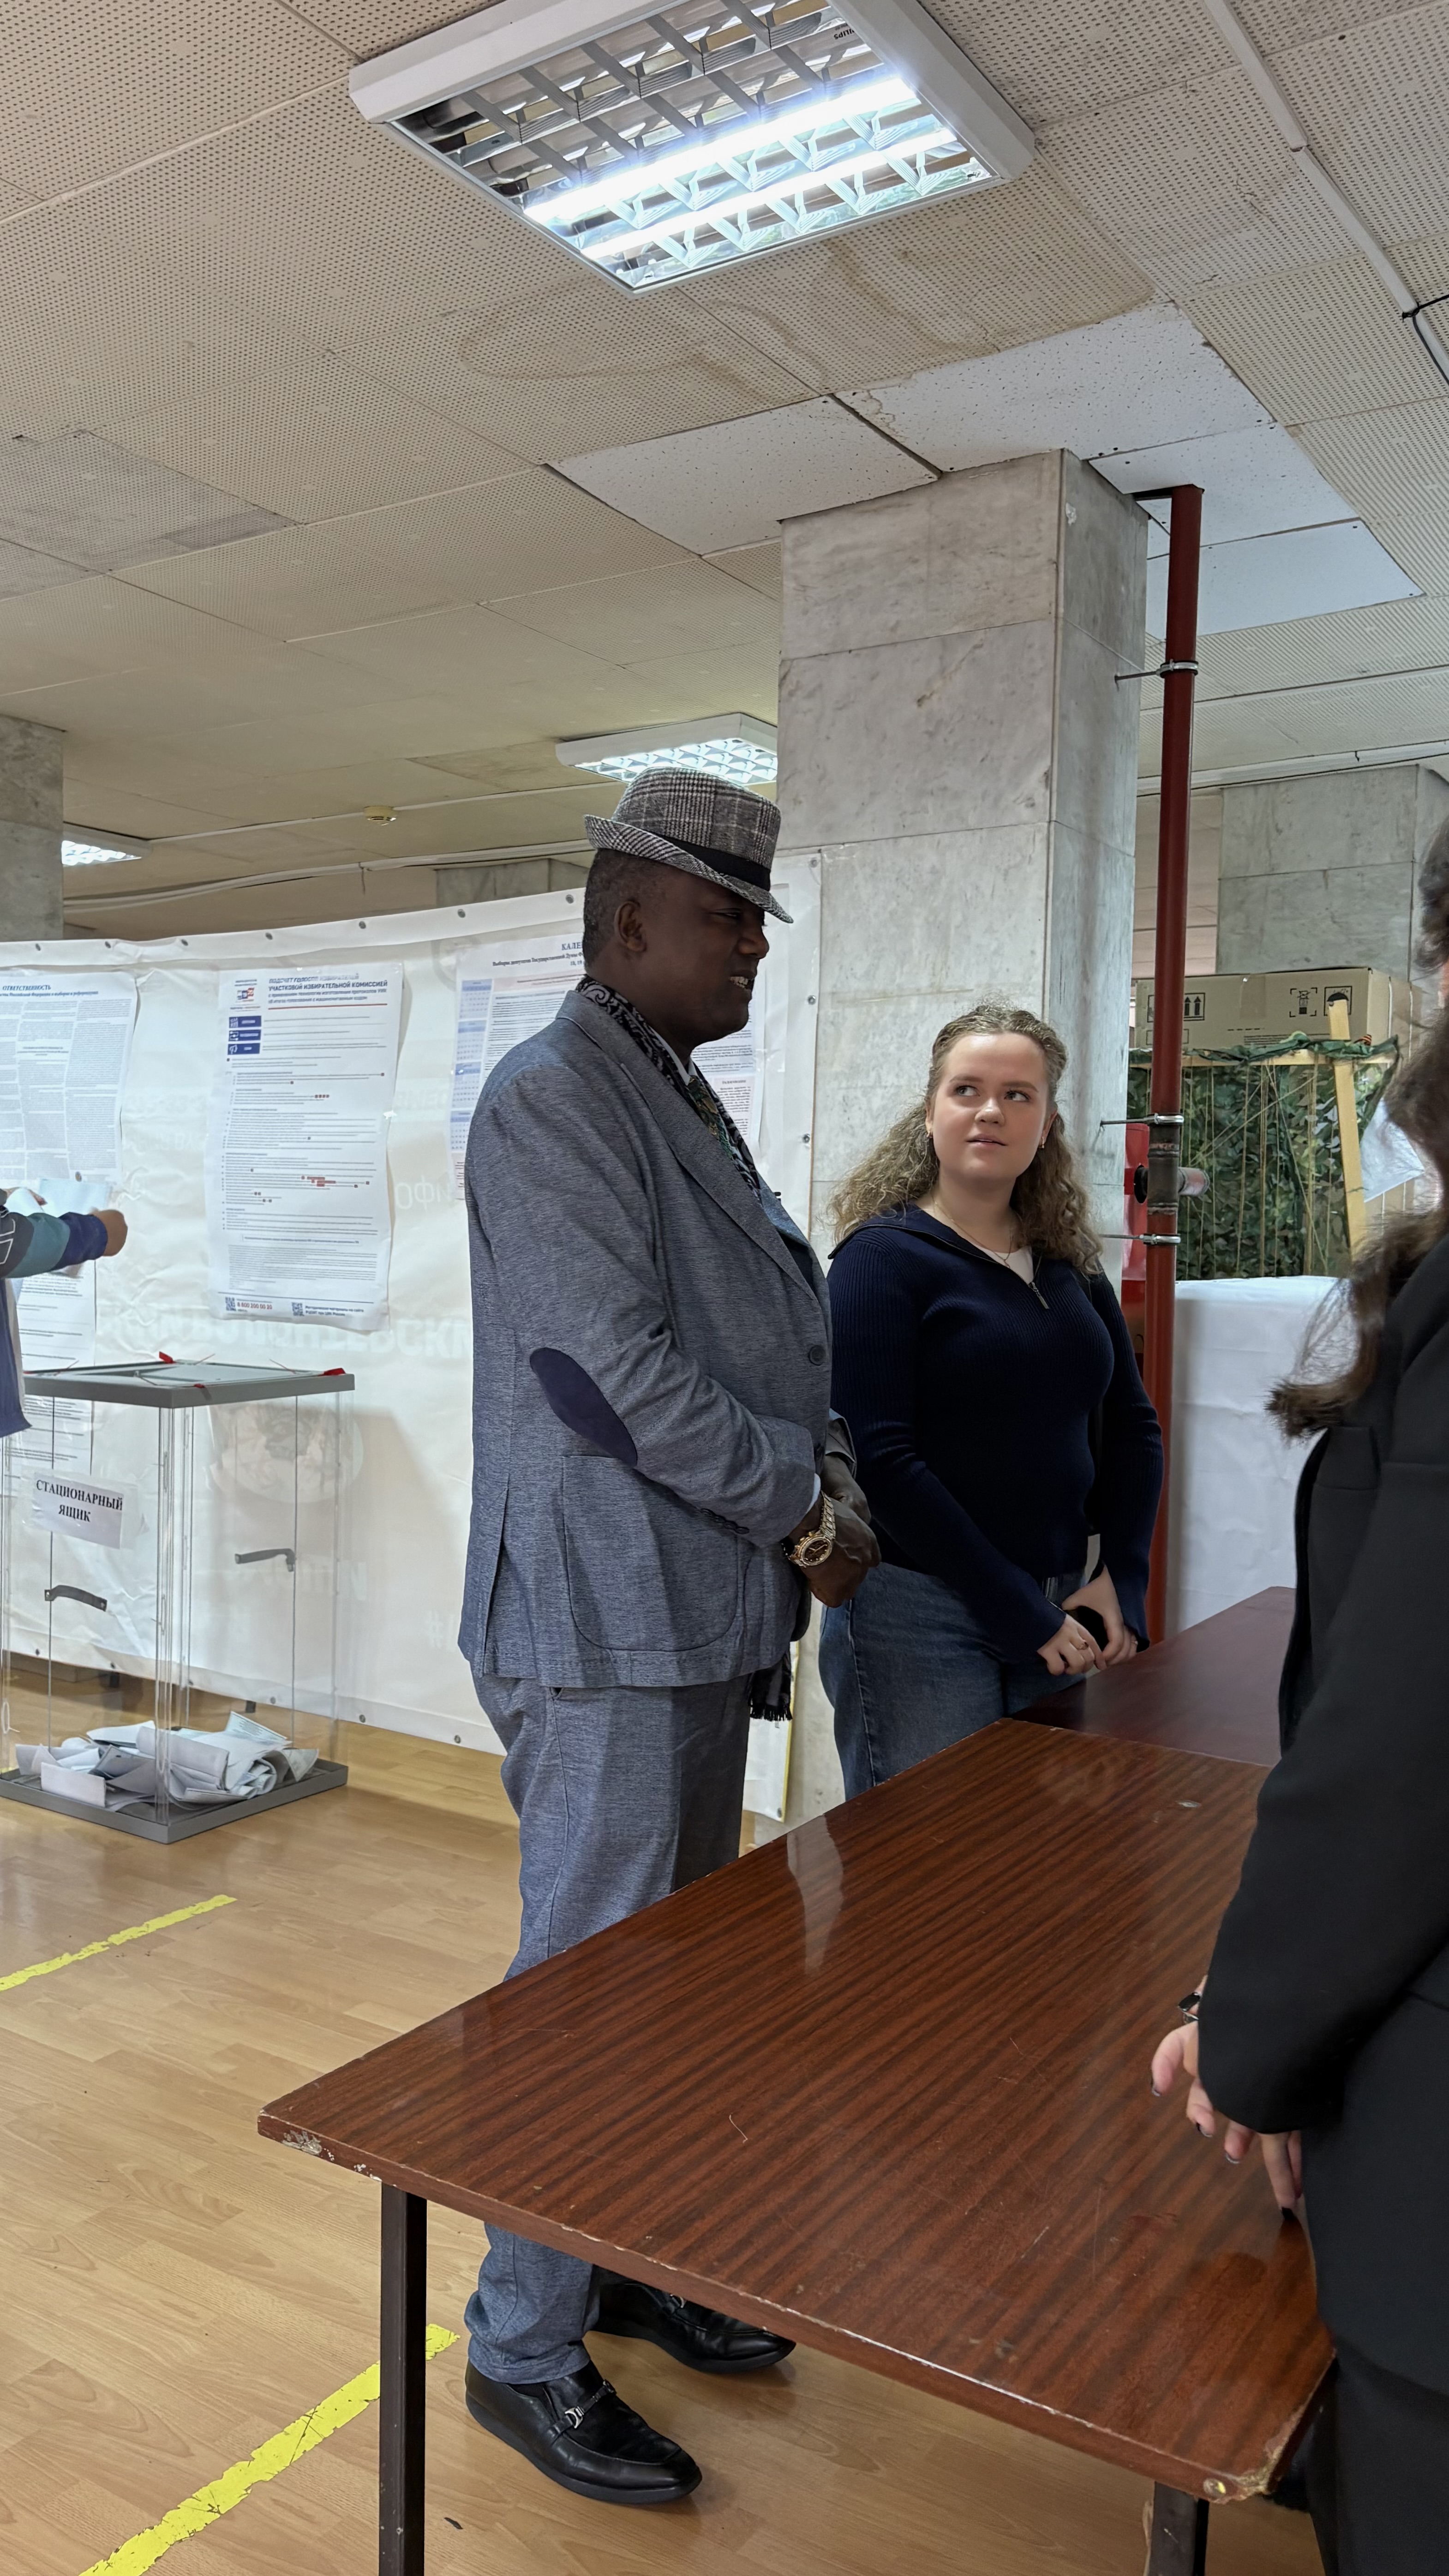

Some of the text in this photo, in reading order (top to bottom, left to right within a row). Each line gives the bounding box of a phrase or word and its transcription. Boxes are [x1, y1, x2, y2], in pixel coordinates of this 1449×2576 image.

[562, 942, 583, 950] КАЛЕ
[304, 981, 350, 989] ИЗБИРАТЕЛЬНОЙ
[36, 1480, 123, 1511] СТАЦИОНАРНЫЙ
[58, 1504, 91, 1522] ЯЩИК
